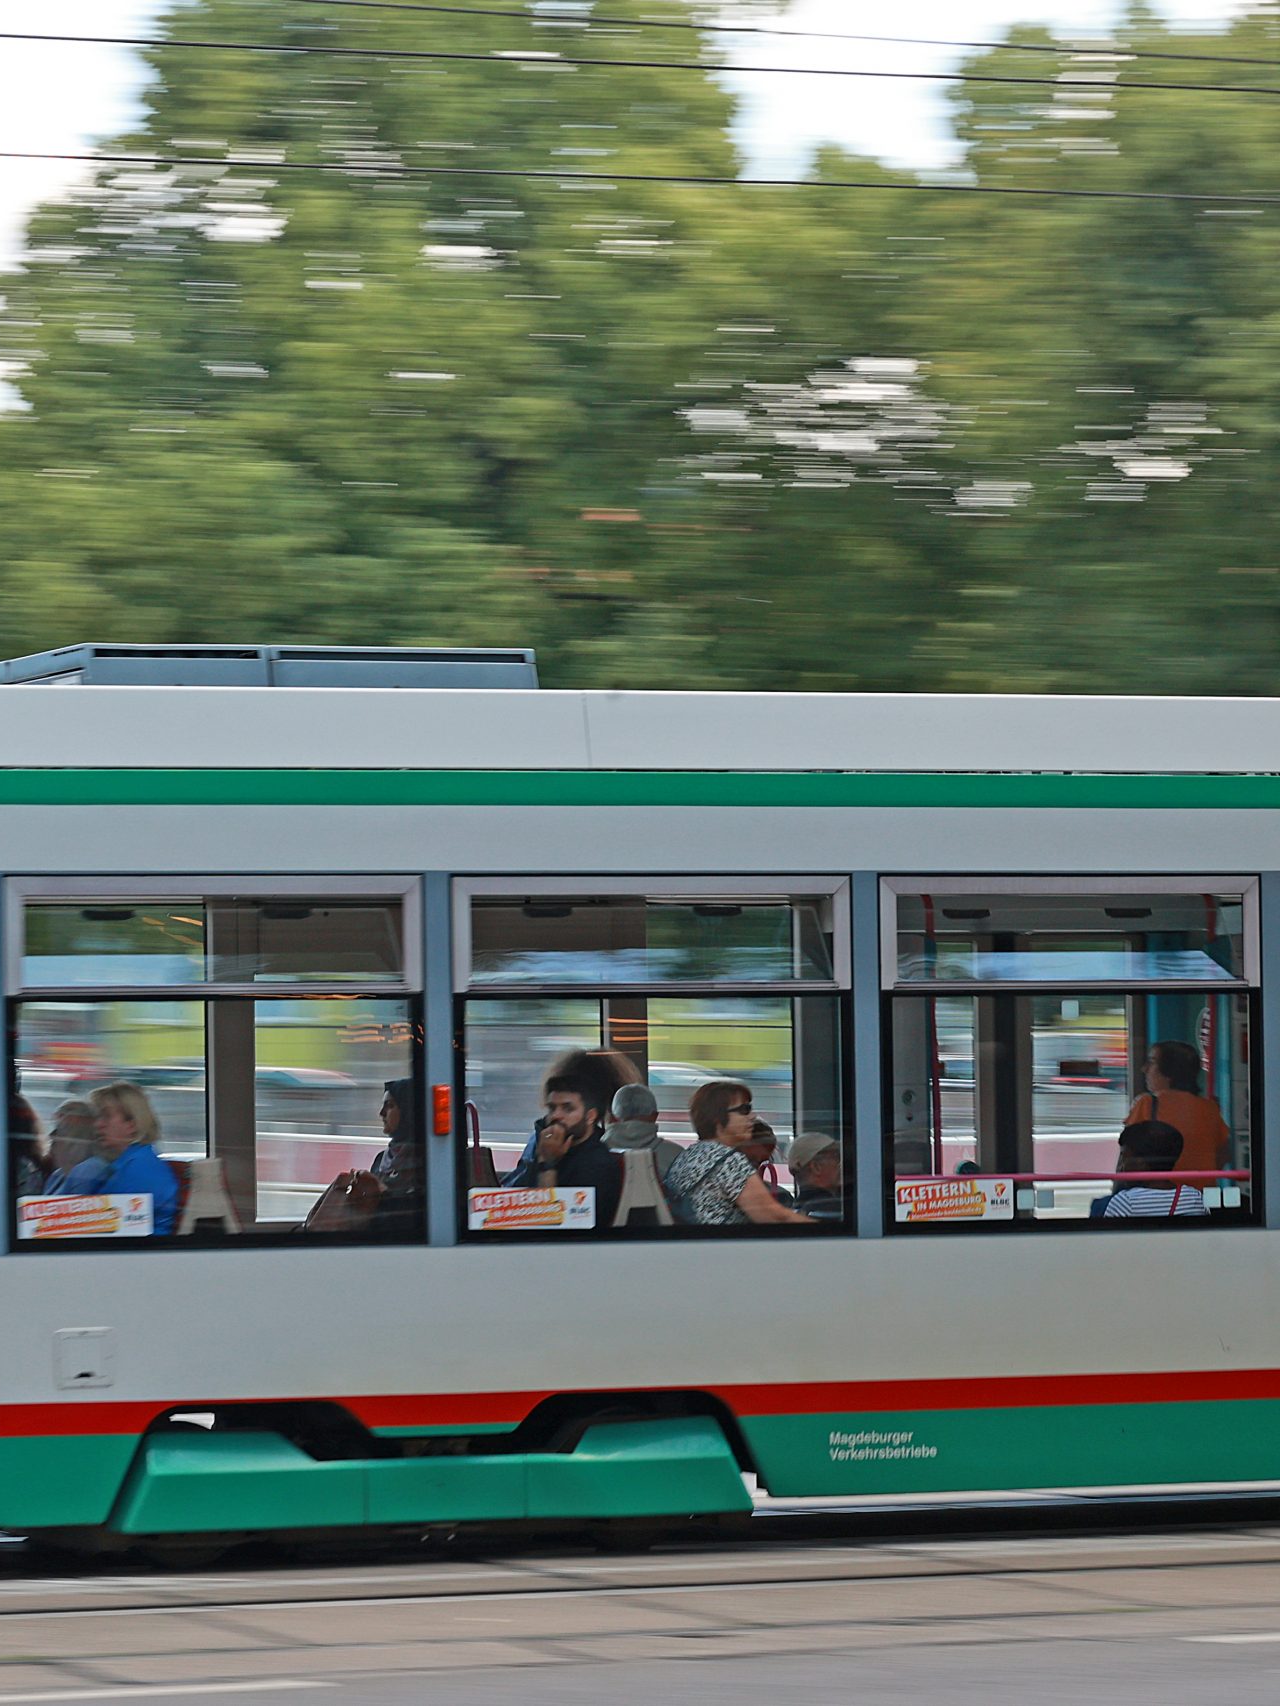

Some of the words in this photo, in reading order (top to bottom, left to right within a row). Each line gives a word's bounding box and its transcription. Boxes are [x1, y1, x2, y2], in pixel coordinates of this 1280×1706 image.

[474, 1188, 551, 1210] KLETTERN
[900, 1181, 972, 1202] KLETTERN
[916, 1201, 927, 1212] IN
[829, 1430, 914, 1448] Magdeburger
[829, 1444, 938, 1462] Verkehrsbetriebe
